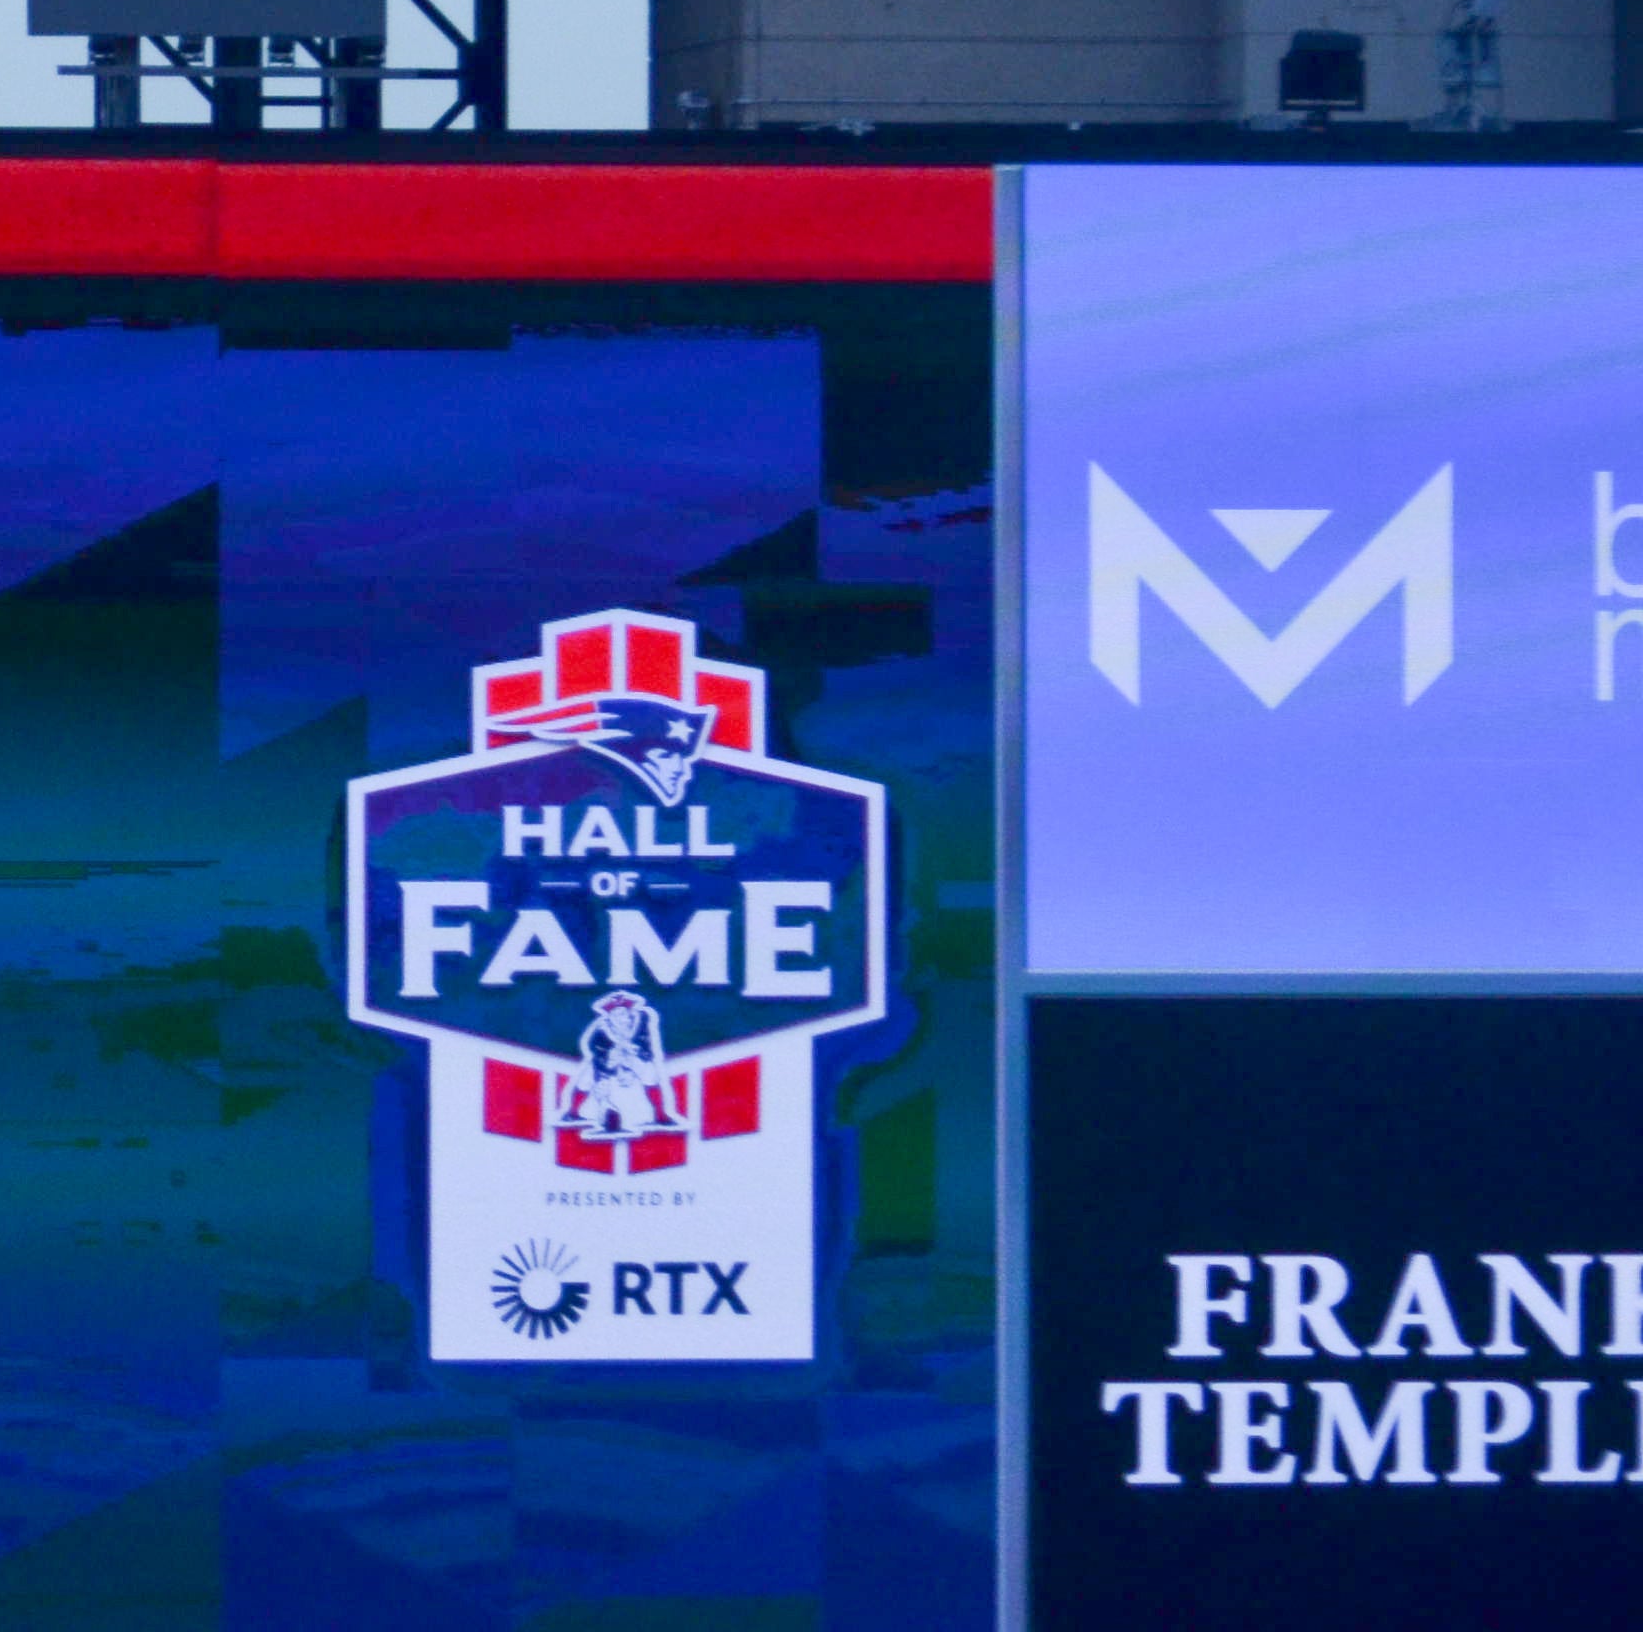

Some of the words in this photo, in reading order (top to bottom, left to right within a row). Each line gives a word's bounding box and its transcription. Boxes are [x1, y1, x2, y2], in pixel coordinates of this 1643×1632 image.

[502, 805, 736, 857] HALL
[591, 872, 639, 897] OF
[398, 881, 832, 998] FAME
[547, 1192, 663, 1206] PRESENTED
[674, 1192, 696, 1206] BY
[614, 1262, 749, 1315] RTX
